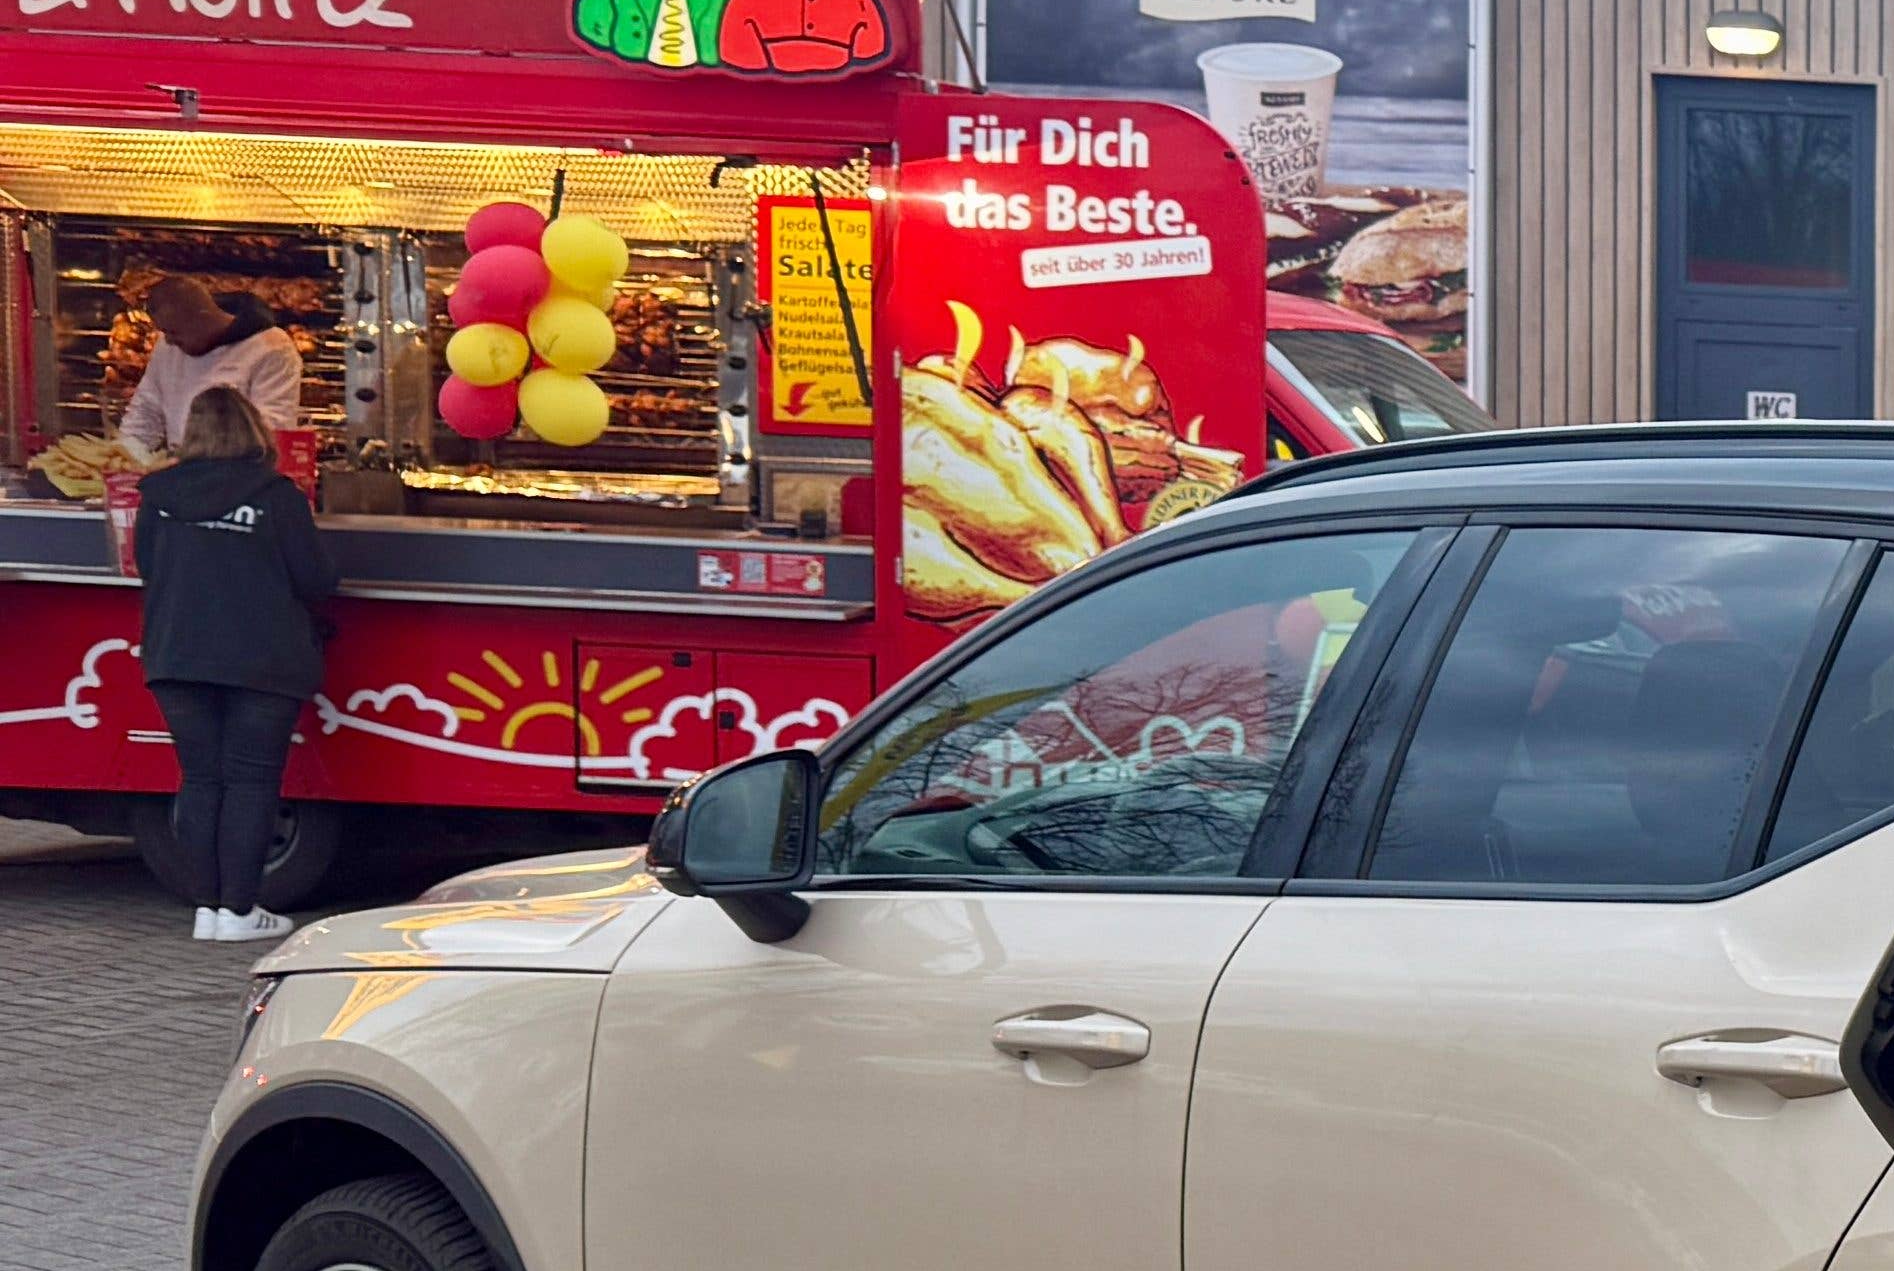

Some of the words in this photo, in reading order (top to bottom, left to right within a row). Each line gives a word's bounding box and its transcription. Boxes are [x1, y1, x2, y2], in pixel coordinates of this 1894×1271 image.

[946, 114, 1027, 165] Für
[1040, 116, 1150, 168] Dich
[945, 178, 1032, 231] das
[1046, 184, 1198, 236] Beste.
[778, 215, 823, 233] Jede
[834, 218, 867, 239] Tag
[1030, 261, 1062, 277] seit
[1067, 253, 1106, 272] über
[1114, 251, 1135, 270] 30
[1140, 247, 1206, 269] Jahren!
[1754, 395, 1792, 418] WC
